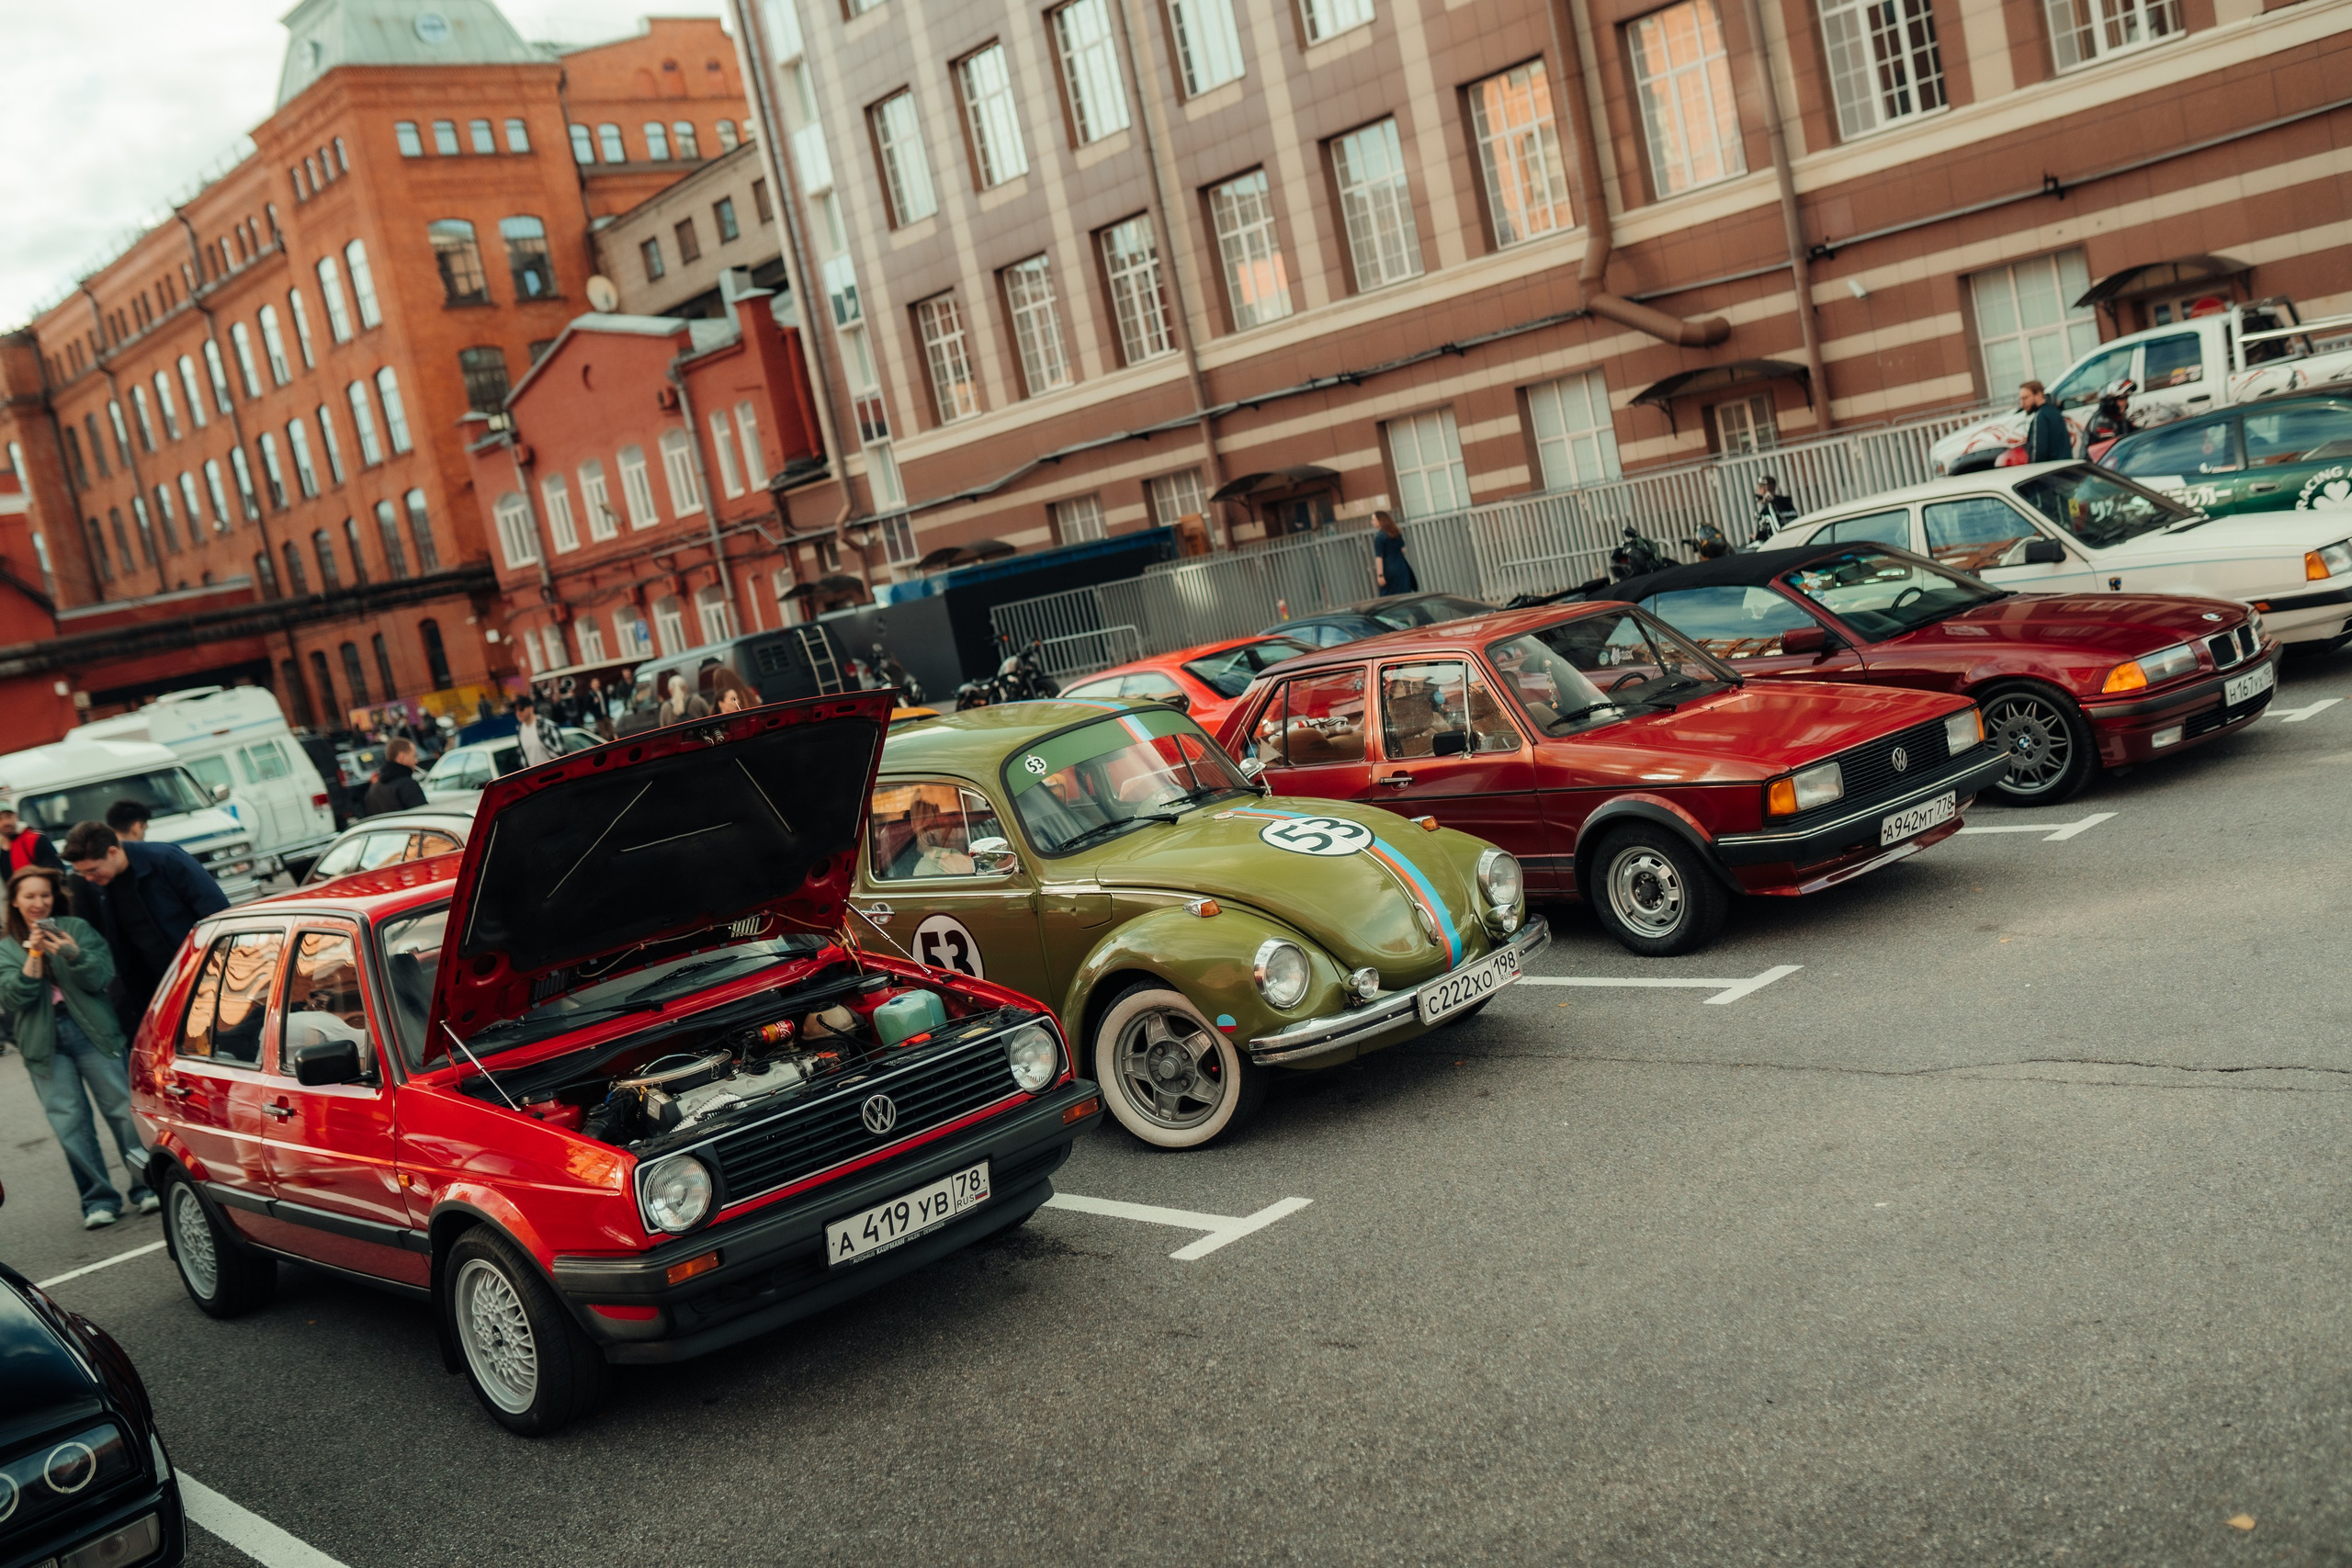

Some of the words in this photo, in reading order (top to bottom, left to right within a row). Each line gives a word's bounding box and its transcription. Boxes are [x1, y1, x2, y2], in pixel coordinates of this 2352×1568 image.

[1027, 758, 1045, 773] 53
[1936, 795, 1953, 815] 778
[1272, 818, 1364, 852] 53
[921, 930, 976, 977] 53
[1493, 951, 1516, 975] 198
[1500, 971, 1512, 982] RUS
[956, 1169, 980, 1198] 78
[956, 1194, 975, 1209] RUS
[876, 1237, 905, 1255] KAUFMANN
